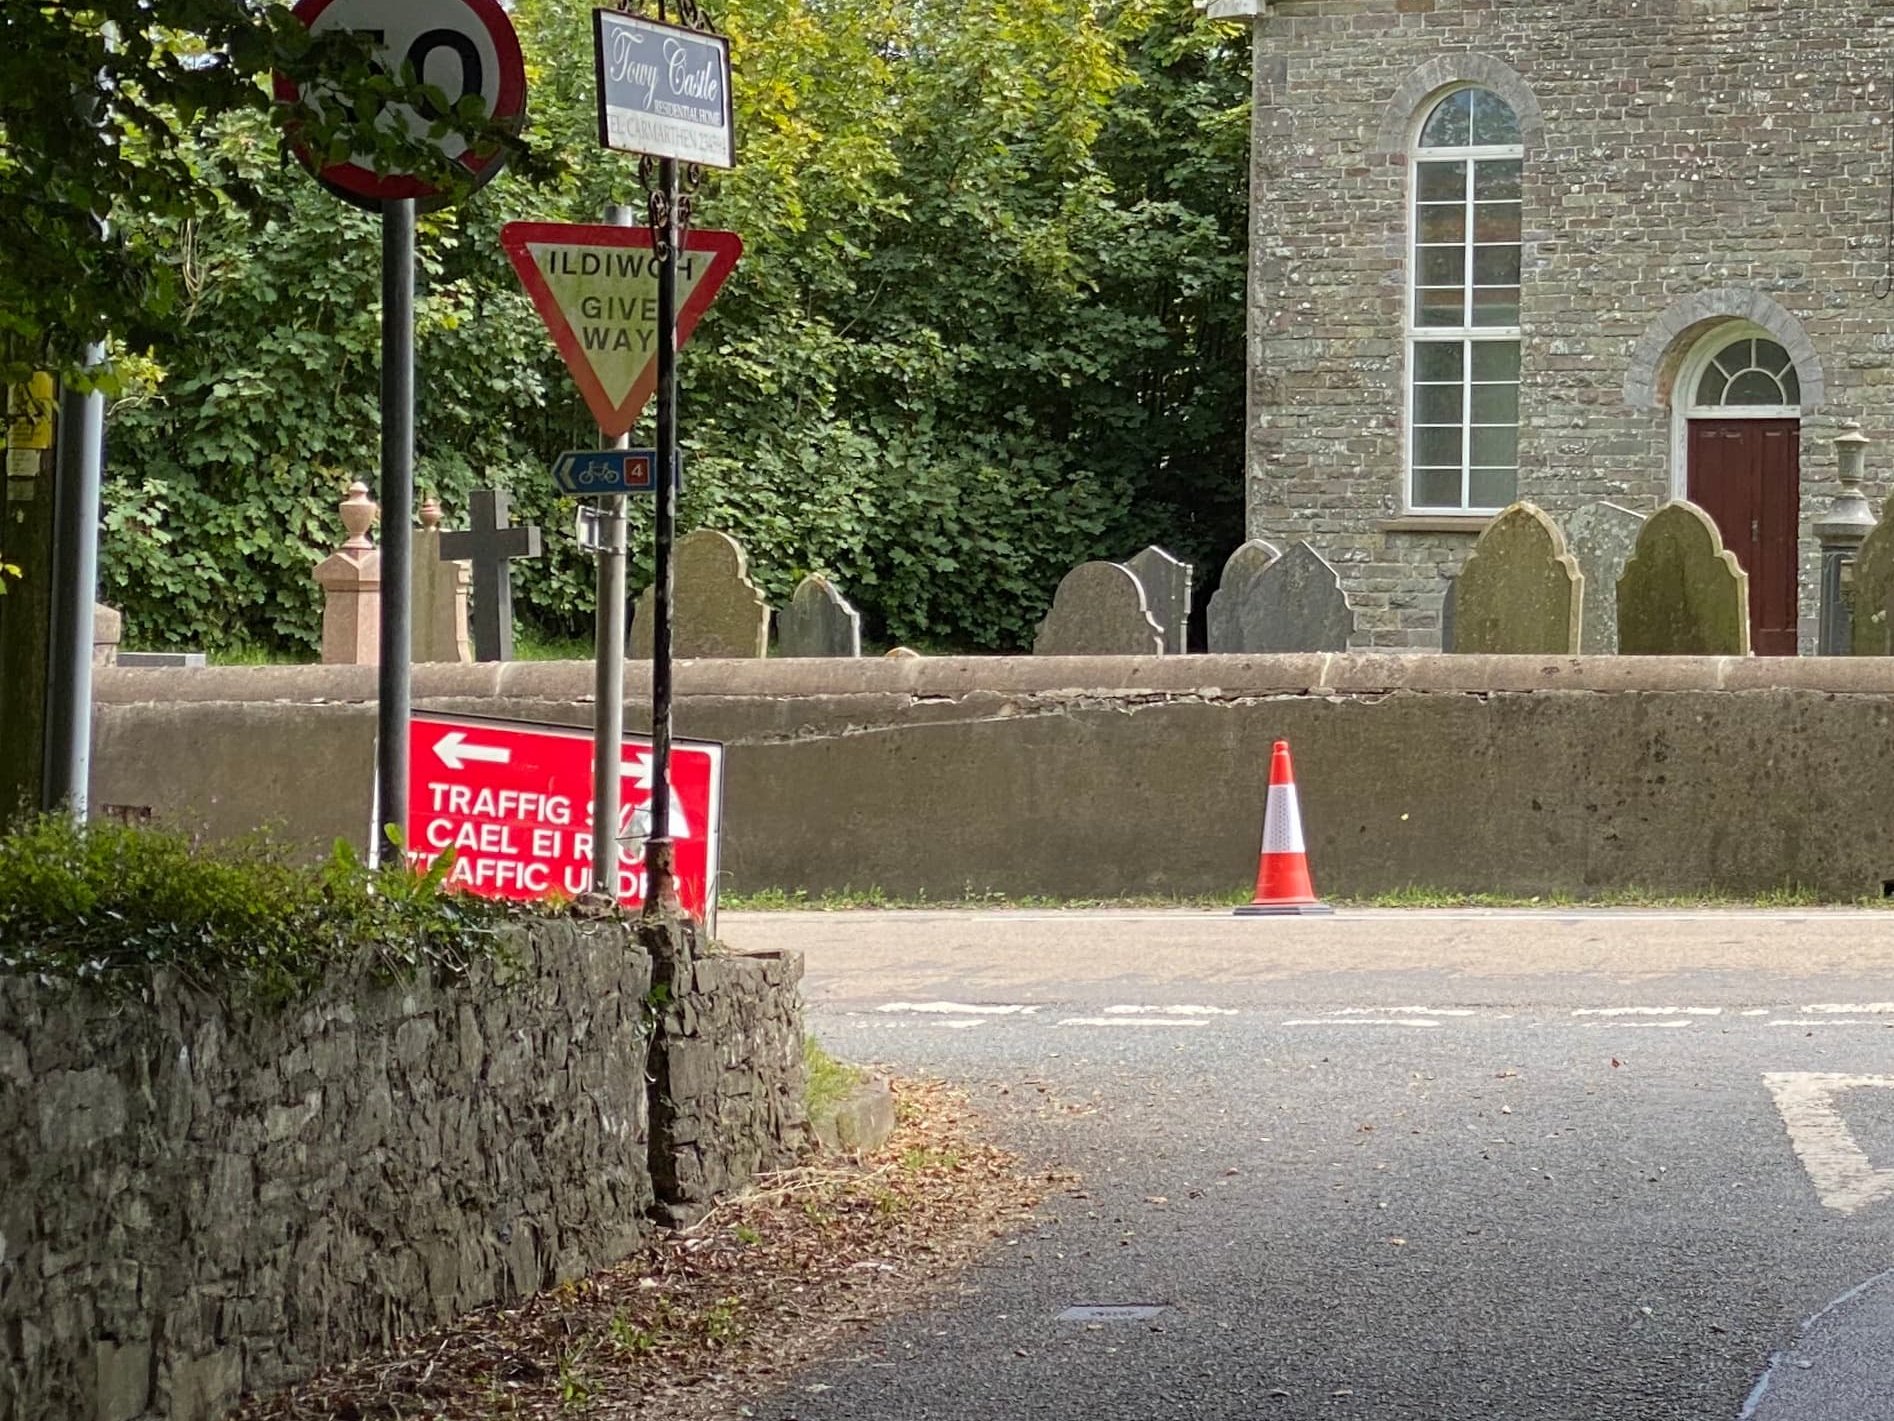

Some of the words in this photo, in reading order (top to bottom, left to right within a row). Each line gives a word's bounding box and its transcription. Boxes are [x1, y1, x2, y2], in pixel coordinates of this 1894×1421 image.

[317, 28, 483, 133] 0
[610, 27, 657, 110] Towy
[663, 37, 718, 101] Castle
[653, 99, 698, 122] RESIDENTIAL
[627, 115, 698, 149] CARMARTHEN
[581, 296, 657, 322] GIVE
[582, 326, 655, 352] WAY
[631, 463, 643, 477] 4
[428, 782, 571, 825] TRAFFIG
[426, 819, 518, 855] CAEL
[532, 828, 561, 858] EI
